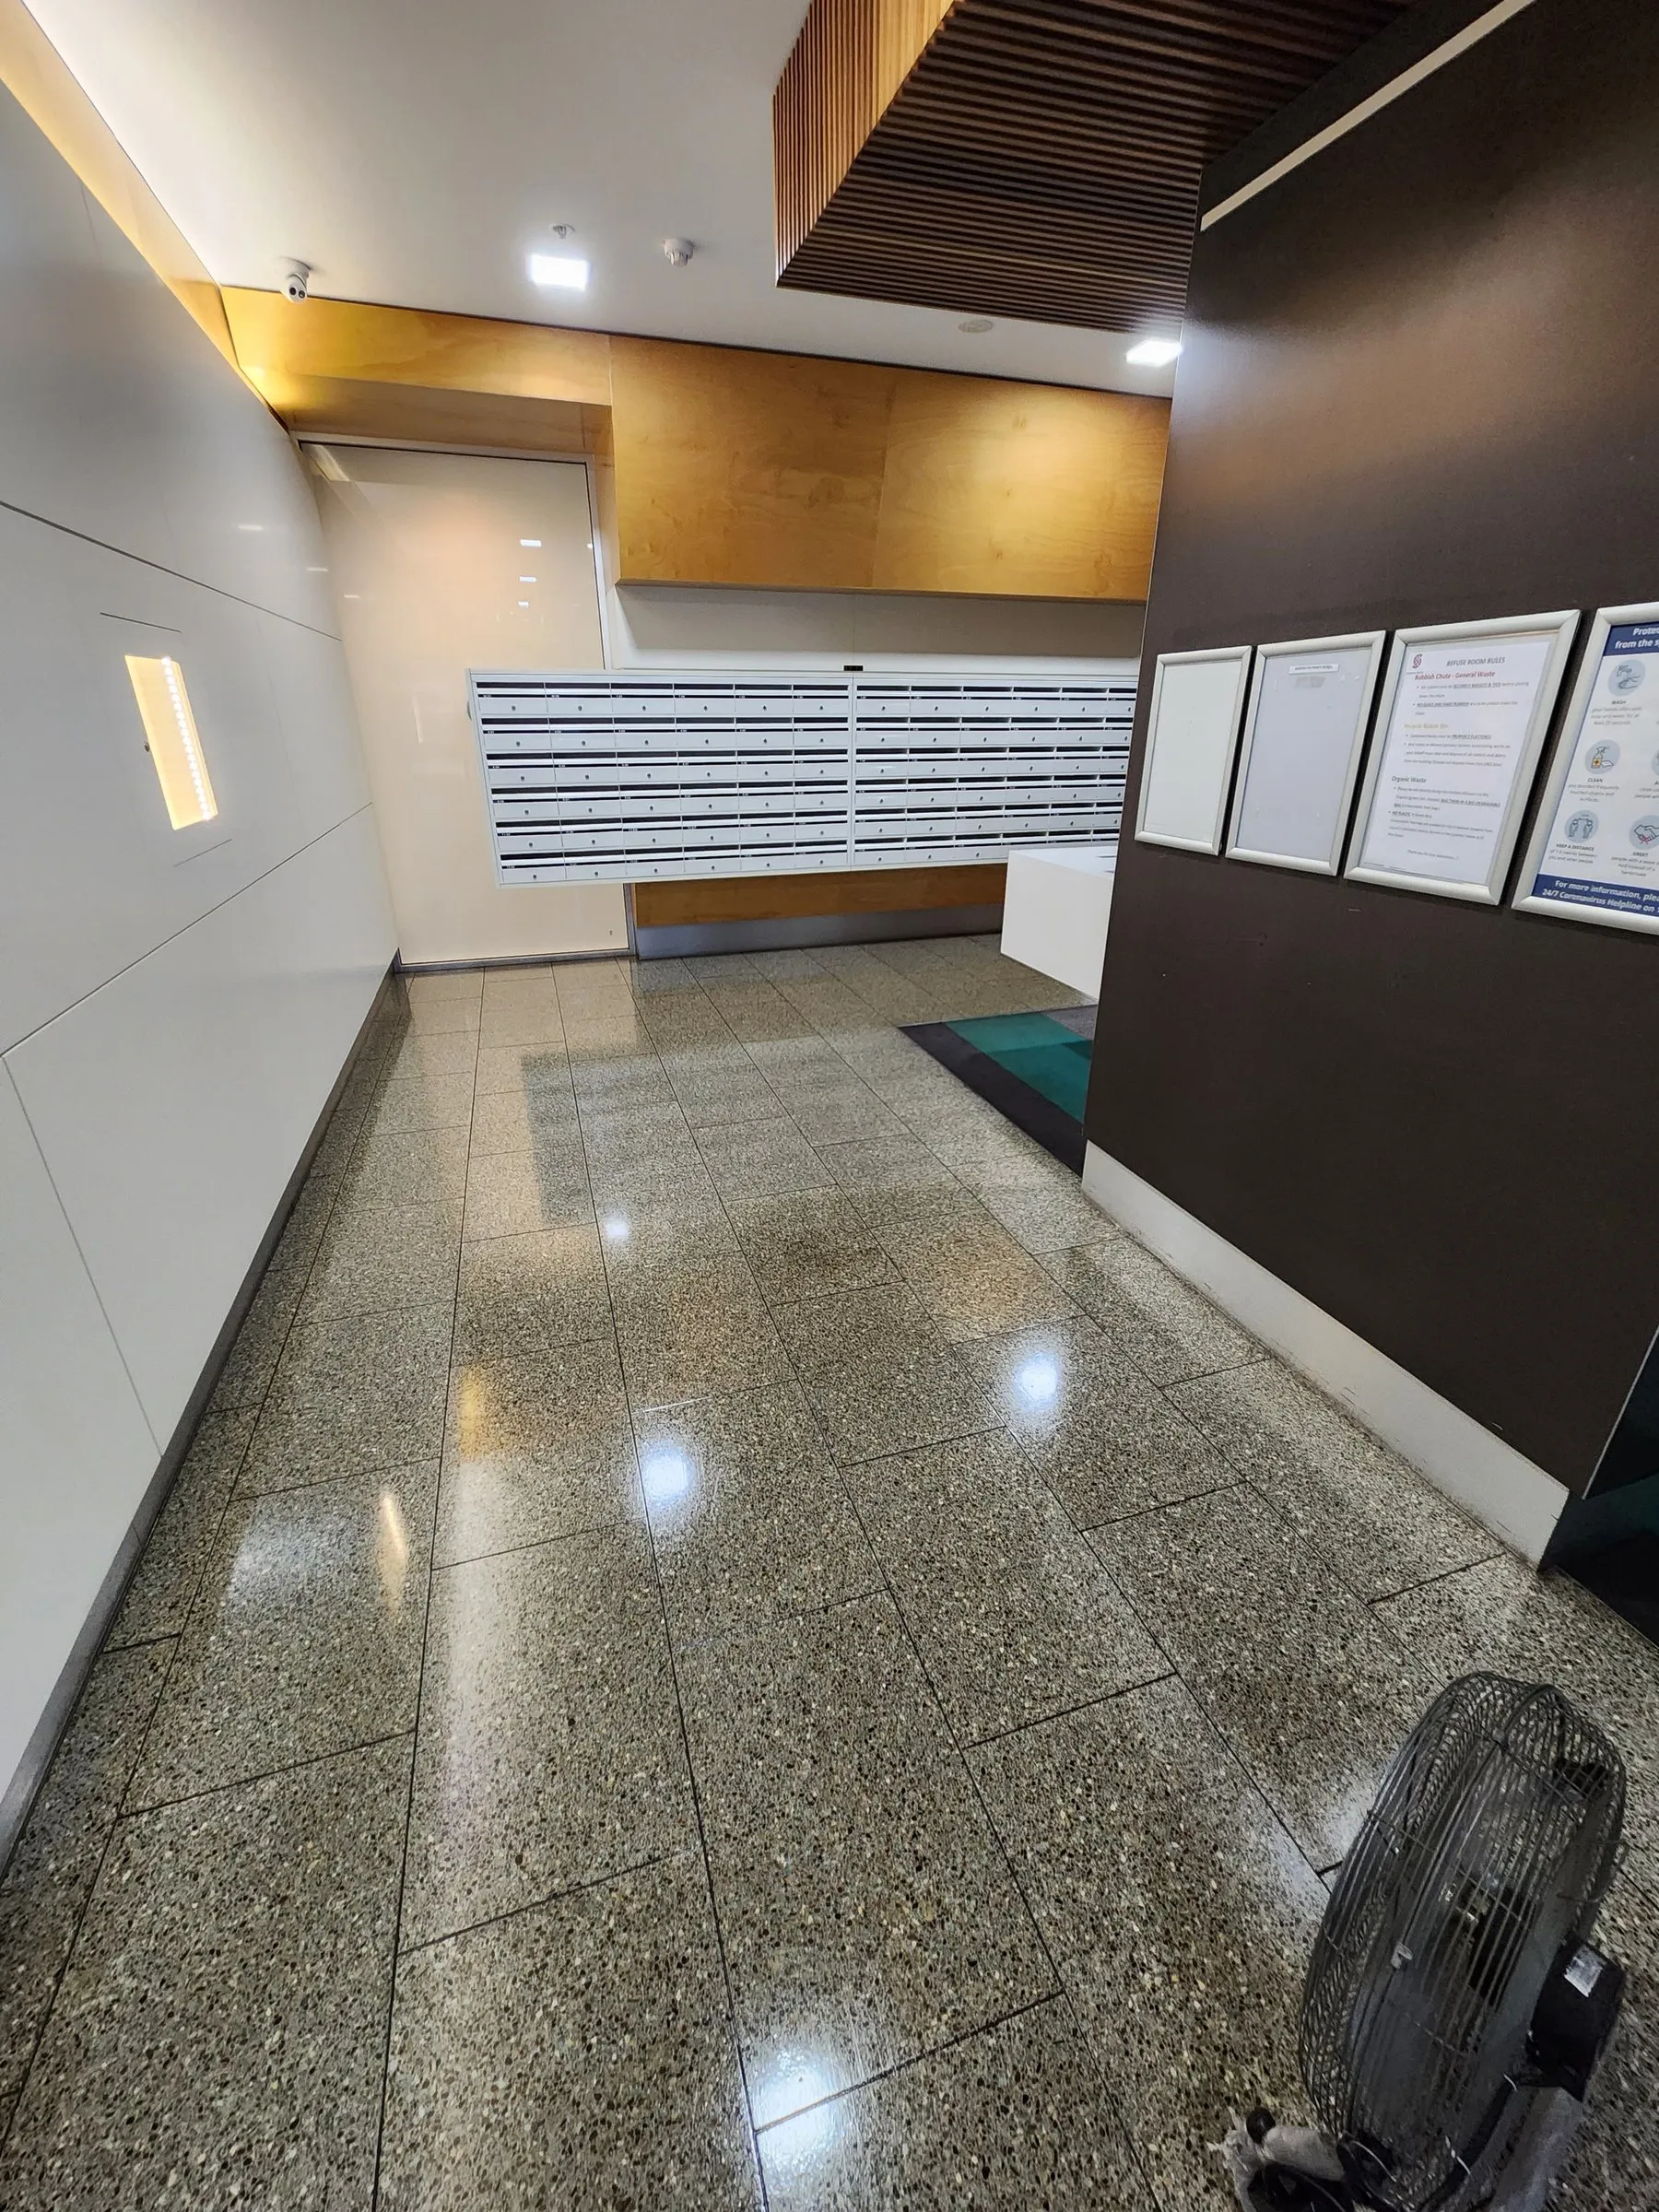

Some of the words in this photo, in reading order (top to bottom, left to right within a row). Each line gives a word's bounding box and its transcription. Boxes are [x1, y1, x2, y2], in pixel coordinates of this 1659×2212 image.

[1615, 641, 1637, 649] from
[1638, 639, 1653, 647] the
[1542, 888, 1559, 897] 24/7
[1559, 891, 1606, 904] Coronavirus
[1606, 899, 1642, 910] Helpline
[1555, 879, 1568, 888] For
[1568, 883, 1589, 891] more
[1591, 886, 1641, 900] information,
